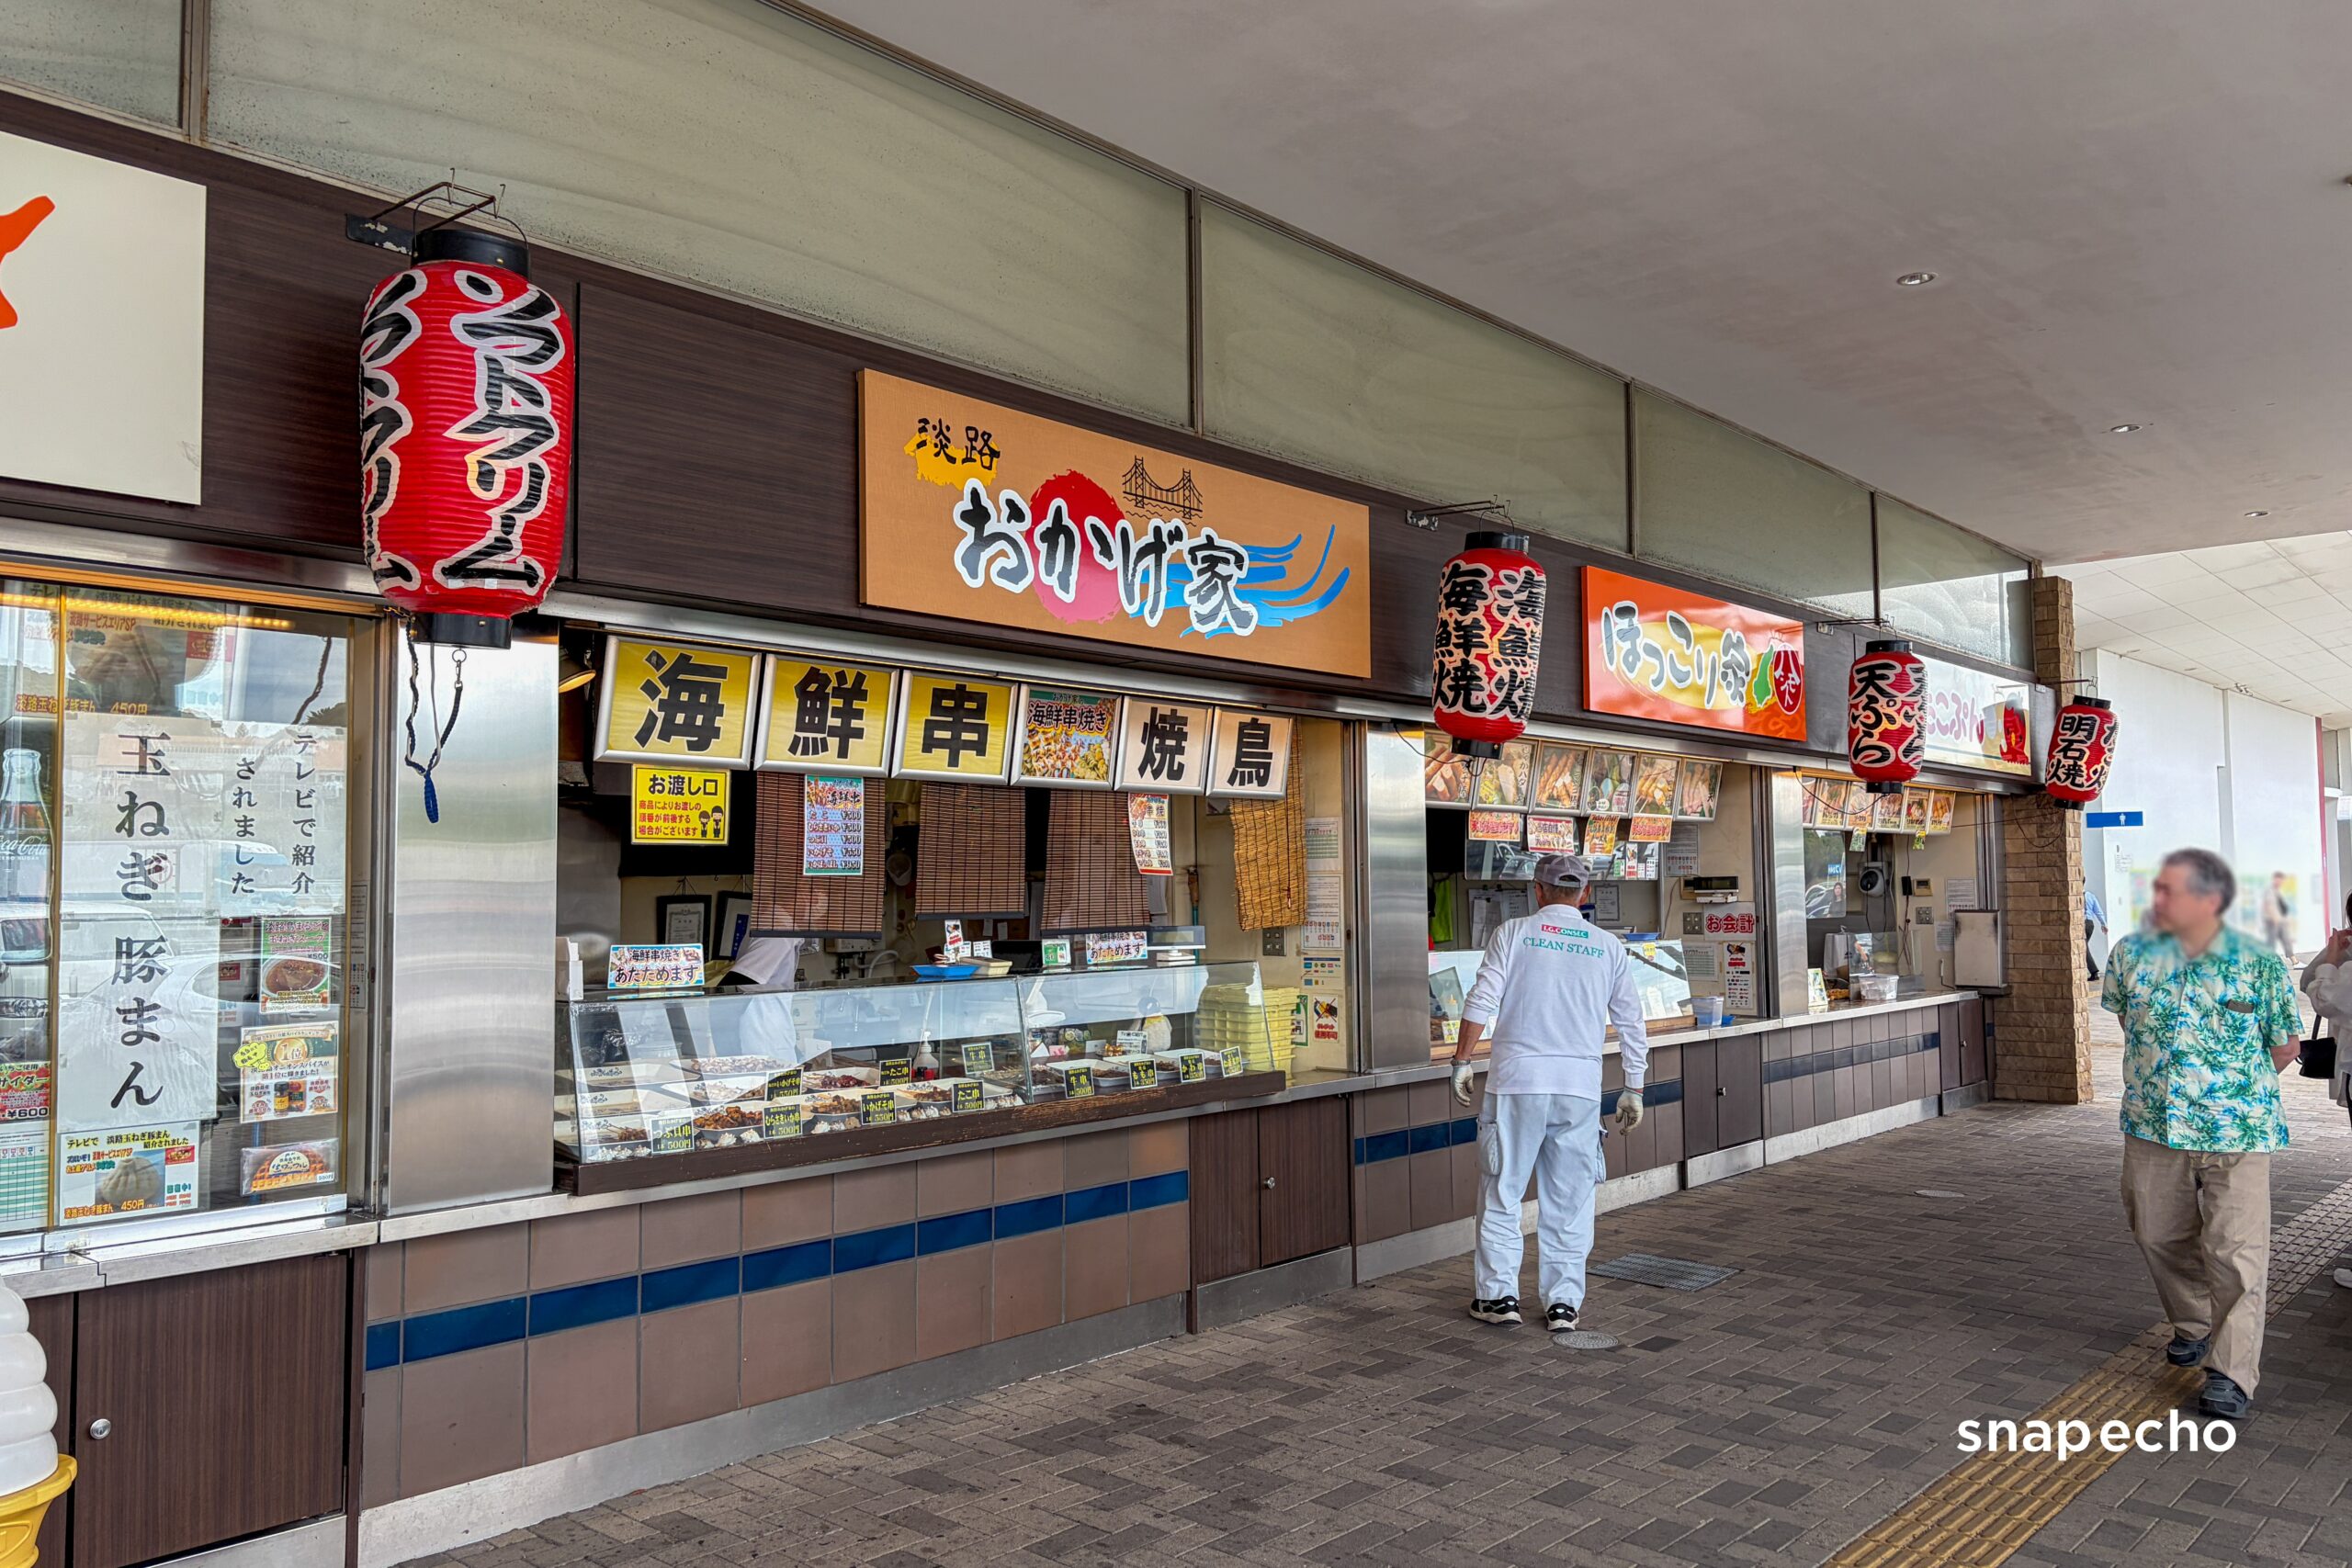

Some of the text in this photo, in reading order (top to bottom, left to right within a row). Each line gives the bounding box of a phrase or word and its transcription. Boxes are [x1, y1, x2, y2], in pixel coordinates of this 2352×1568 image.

[916, 418, 1001, 470] 淡路
[953, 477, 1259, 637] おかげ家
[634, 649, 989, 768] 海 鮮 串
[1849, 660, 1902, 767] 天ぷら
[1027, 702, 1108, 732] 海鮮串焼き
[1138, 706, 1273, 787] 焼 鳥
[2046, 713, 2101, 792] 明石焼
[649, 773, 718, 796] お渡し口
[639, 800, 702, 811] 商品によりお渡しの
[291, 733, 318, 896] テレビで紹介
[639, 812, 691, 824] 順番が前後する
[841, 809, 862, 820] ¥500
[231, 757, 258, 896] されました
[639, 825, 698, 837] 場合がございます
[841, 822, 862, 833] ¥500
[841, 834, 862, 845] ¥500
[111, 731, 172, 1110] 玉ねぎ豚まん
[1706, 914, 1755, 933] お会計
[1090, 942, 1143, 959] あたためます
[1523, 936, 1605, 958] CLEAN STAFF
[629, 949, 681, 963] 海鮮串焼き
[615, 964, 699, 984] あたためます
[279, 1043, 302, 1061] 1位
[889, 1066, 910, 1077] たこ串
[0, 1075, 50, 1088] サイダー
[957, 1089, 980, 1100] たこ串
[7, 1107, 49, 1119] ¥600
[862, 1100, 895, 1111] いかげそ串
[765, 1112, 800, 1127] むらさきいか串
[67, 1130, 171, 1149] テレビで 淡路玉ねぎ豚まん
[653, 1124, 692, 1140] つぶ貝串
[143, 1137, 189, 1149] 紹介されました
[668, 1139, 691, 1150] 500円
[120, 1199, 145, 1211] 450円
